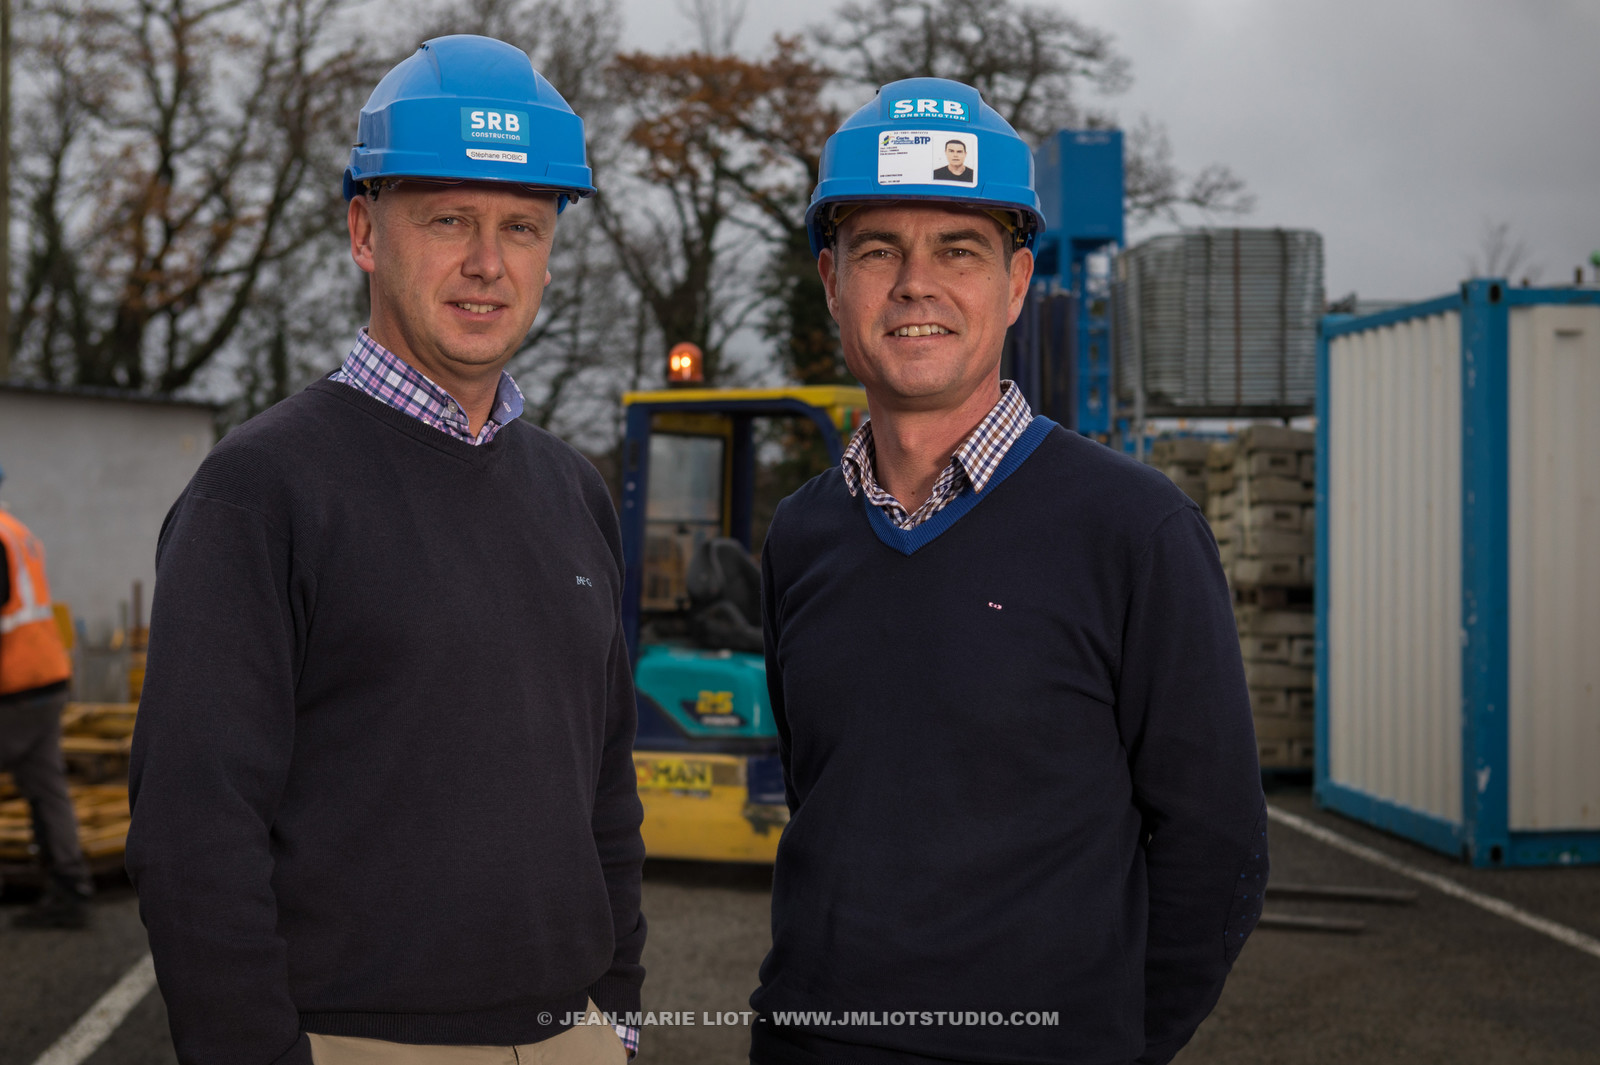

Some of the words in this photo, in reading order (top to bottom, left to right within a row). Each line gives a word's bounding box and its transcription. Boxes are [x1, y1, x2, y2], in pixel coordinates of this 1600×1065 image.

[894, 99, 965, 115] SRB
[471, 111, 520, 132] SRB
[471, 131, 521, 141] CONSTRUCTION
[914, 136, 931, 145] BTP
[502, 153, 523, 161] ROBIC
[696, 690, 734, 714] 25
